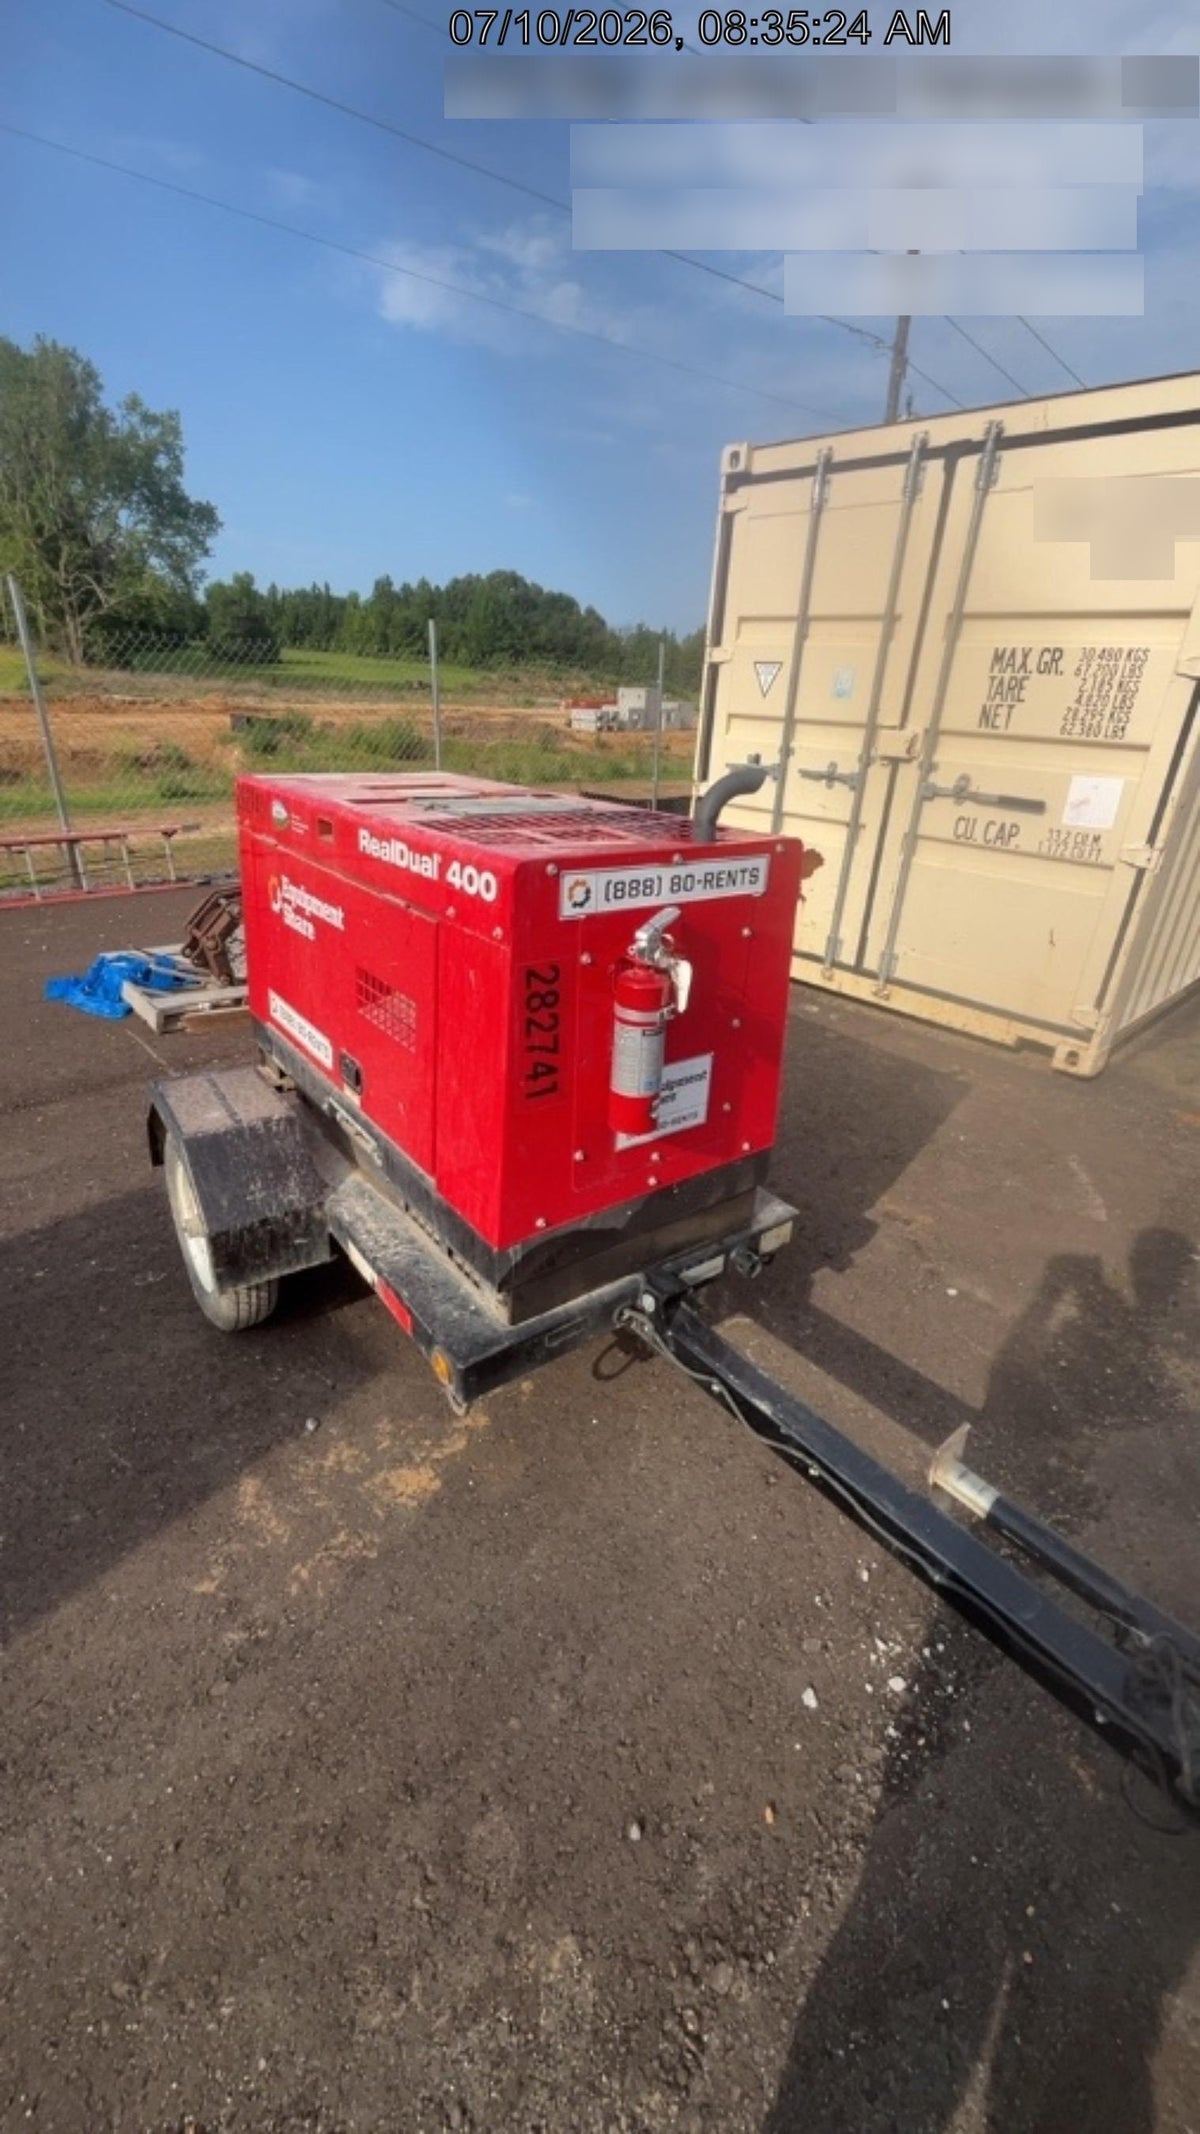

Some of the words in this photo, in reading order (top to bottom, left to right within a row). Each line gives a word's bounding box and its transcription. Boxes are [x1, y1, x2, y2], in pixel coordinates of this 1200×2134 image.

[986, 676, 1030, 702] TARE
[978, 704, 1016, 730] NET
[953, 815, 979, 842] CU.
[983, 820, 1021, 849] CAP.
[445, 860, 497, 902] 400
[604, 874, 663, 903] (888)
[670, 867, 760, 895] 80-RENTS
[525, 964, 560, 1100] 282741
